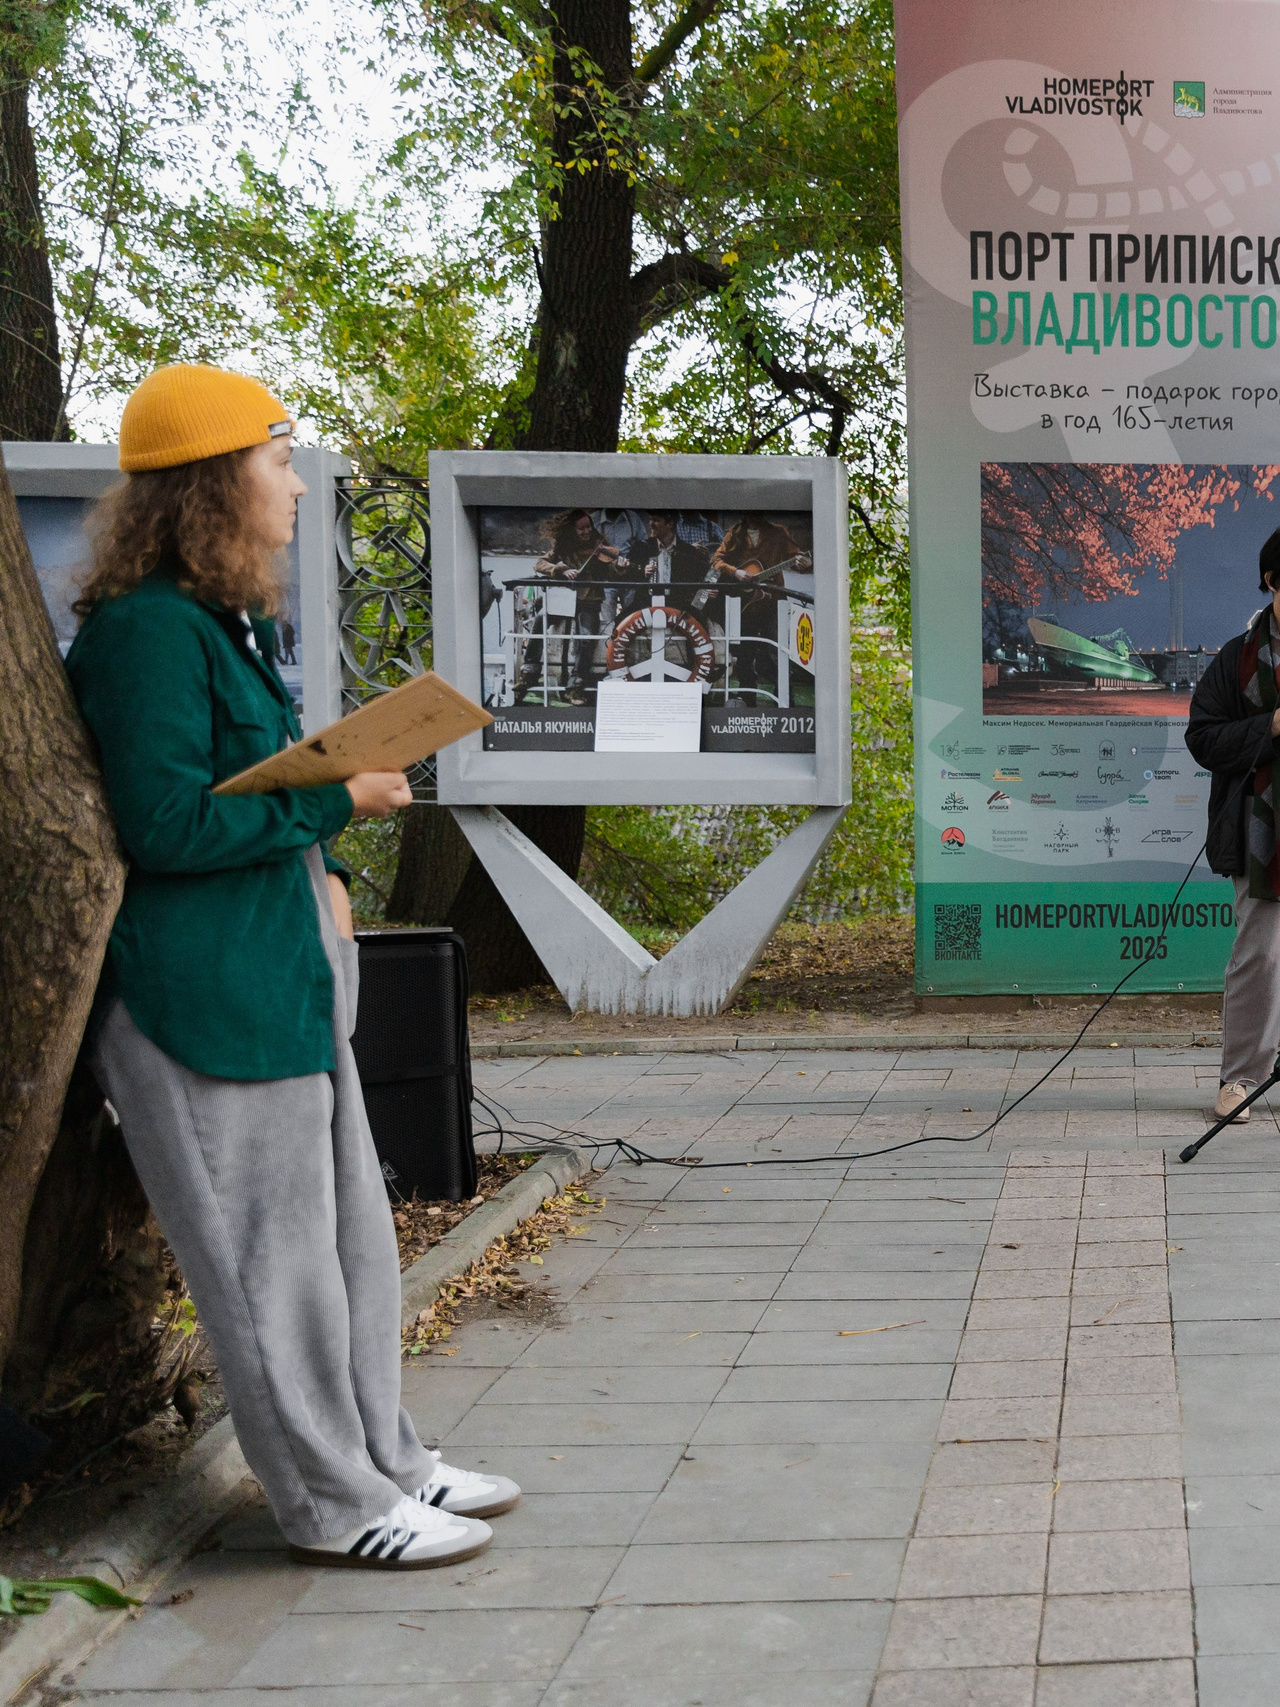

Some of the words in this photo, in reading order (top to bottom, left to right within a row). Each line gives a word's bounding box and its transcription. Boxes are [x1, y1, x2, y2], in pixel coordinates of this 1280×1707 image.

[1044, 77, 1154, 98] HOMEPORT
[1212, 87, 1272, 97] Администрация
[1005, 96, 1143, 117] VLADIVOSTOK
[1212, 98, 1237, 107] города
[1212, 107, 1264, 115] Владивостока
[970, 231, 1075, 281] ПОРТ
[973, 373, 1090, 399] Выставка
[1126, 384, 1221, 408] подарок
[1041, 414, 1053, 429] в
[1064, 414, 1102, 433] год
[1112, 404, 1234, 431] 165-летия
[494, 721, 542, 733] НАТАЛЬЯ
[544, 721, 594, 733] ЯКУНИНА
[728, 716, 778, 726] HOMEPORT
[781, 717, 814, 733] 2012
[982, 719, 1012, 727] Максим
[1048, 719, 1104, 728] Мемориальная
[1105, 720, 1152, 728] Гвардейская
[711, 725, 773, 734] VLADIVOSTOK
[995, 903, 1237, 929] HOMEPORTVLADIVOSTO
[1119, 936, 1168, 960] 2025
[934, 950, 982, 961] ВКОНТАКТЕ
